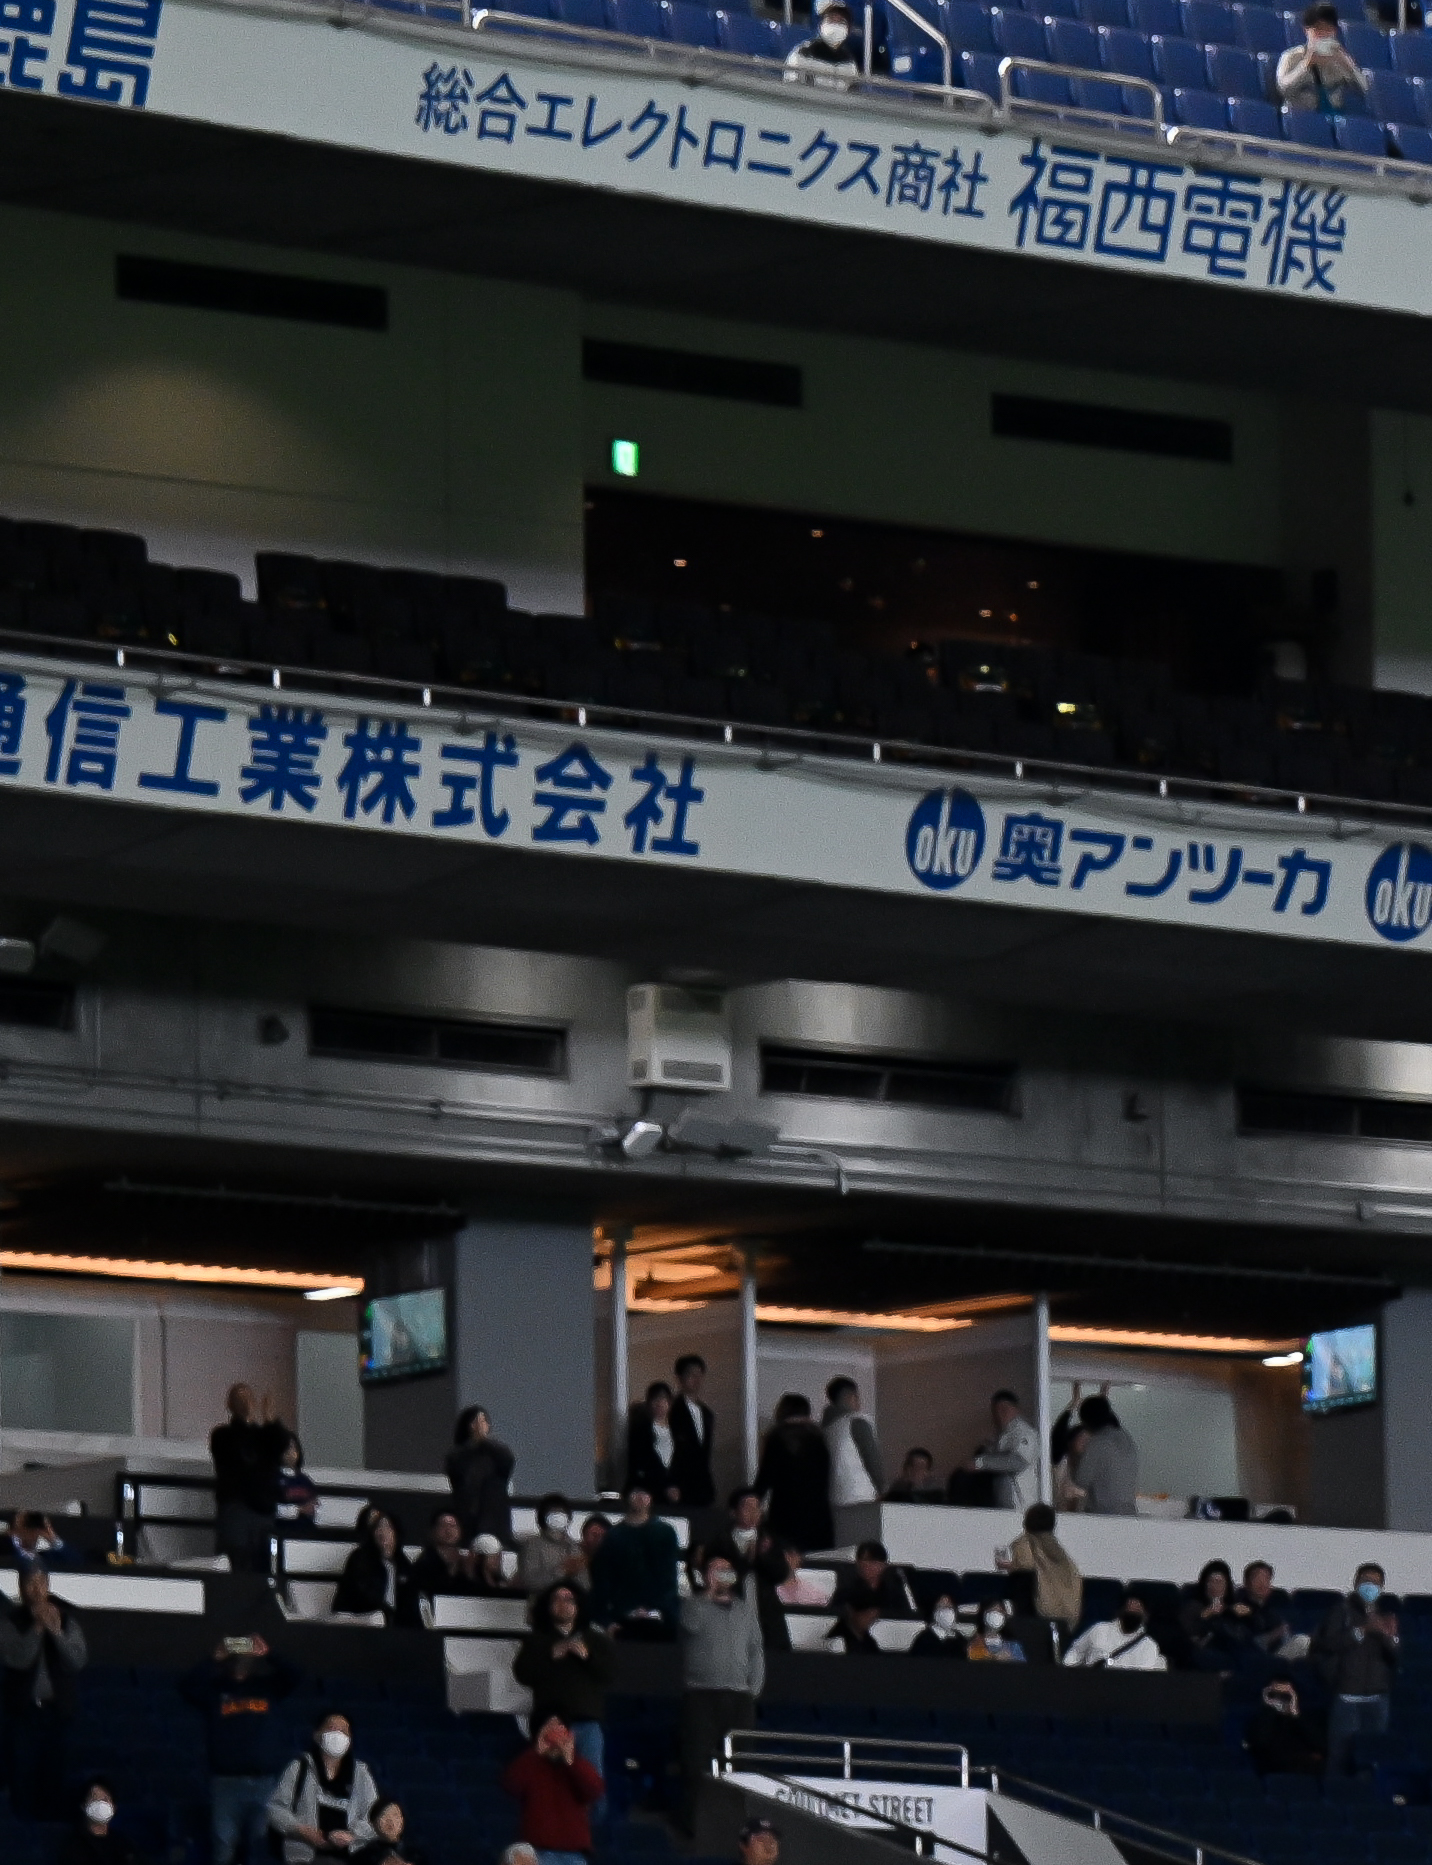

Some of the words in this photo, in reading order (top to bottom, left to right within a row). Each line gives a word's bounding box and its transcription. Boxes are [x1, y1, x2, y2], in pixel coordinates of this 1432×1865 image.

[414, 62, 990, 219] 総合エレクトロニクス商社
[1009, 138, 1346, 292] 福西電機
[992, 812, 1332, 916] 奥アンツーカ
[869, 1794, 933, 1824] STREET
